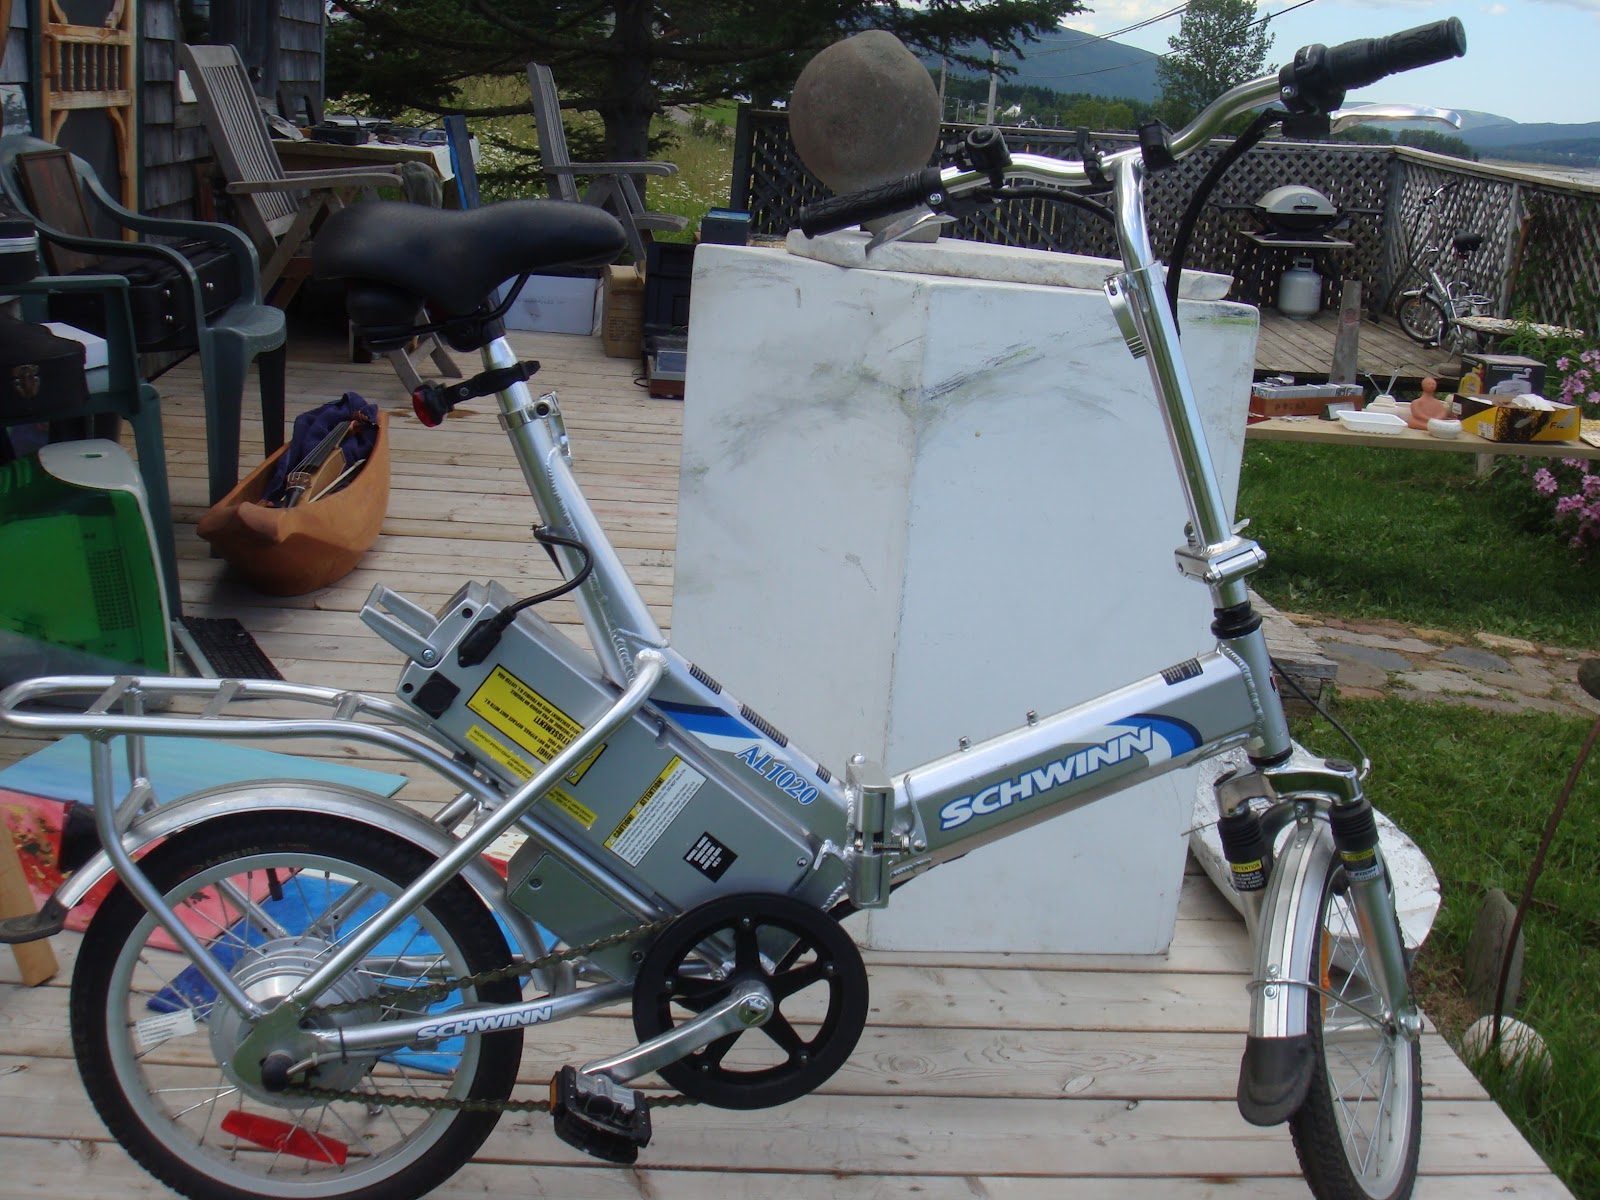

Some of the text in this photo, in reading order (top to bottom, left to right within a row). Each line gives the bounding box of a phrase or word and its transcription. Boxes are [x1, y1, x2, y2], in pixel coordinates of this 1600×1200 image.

[734, 744, 819, 805] AL1020
[940, 723, 1153, 831] SCHWINN
[612, 813, 635, 839] CAUTION!
[638, 776, 665, 806] ATTENTION!
[416, 1005, 553, 1041] SCHWINN
